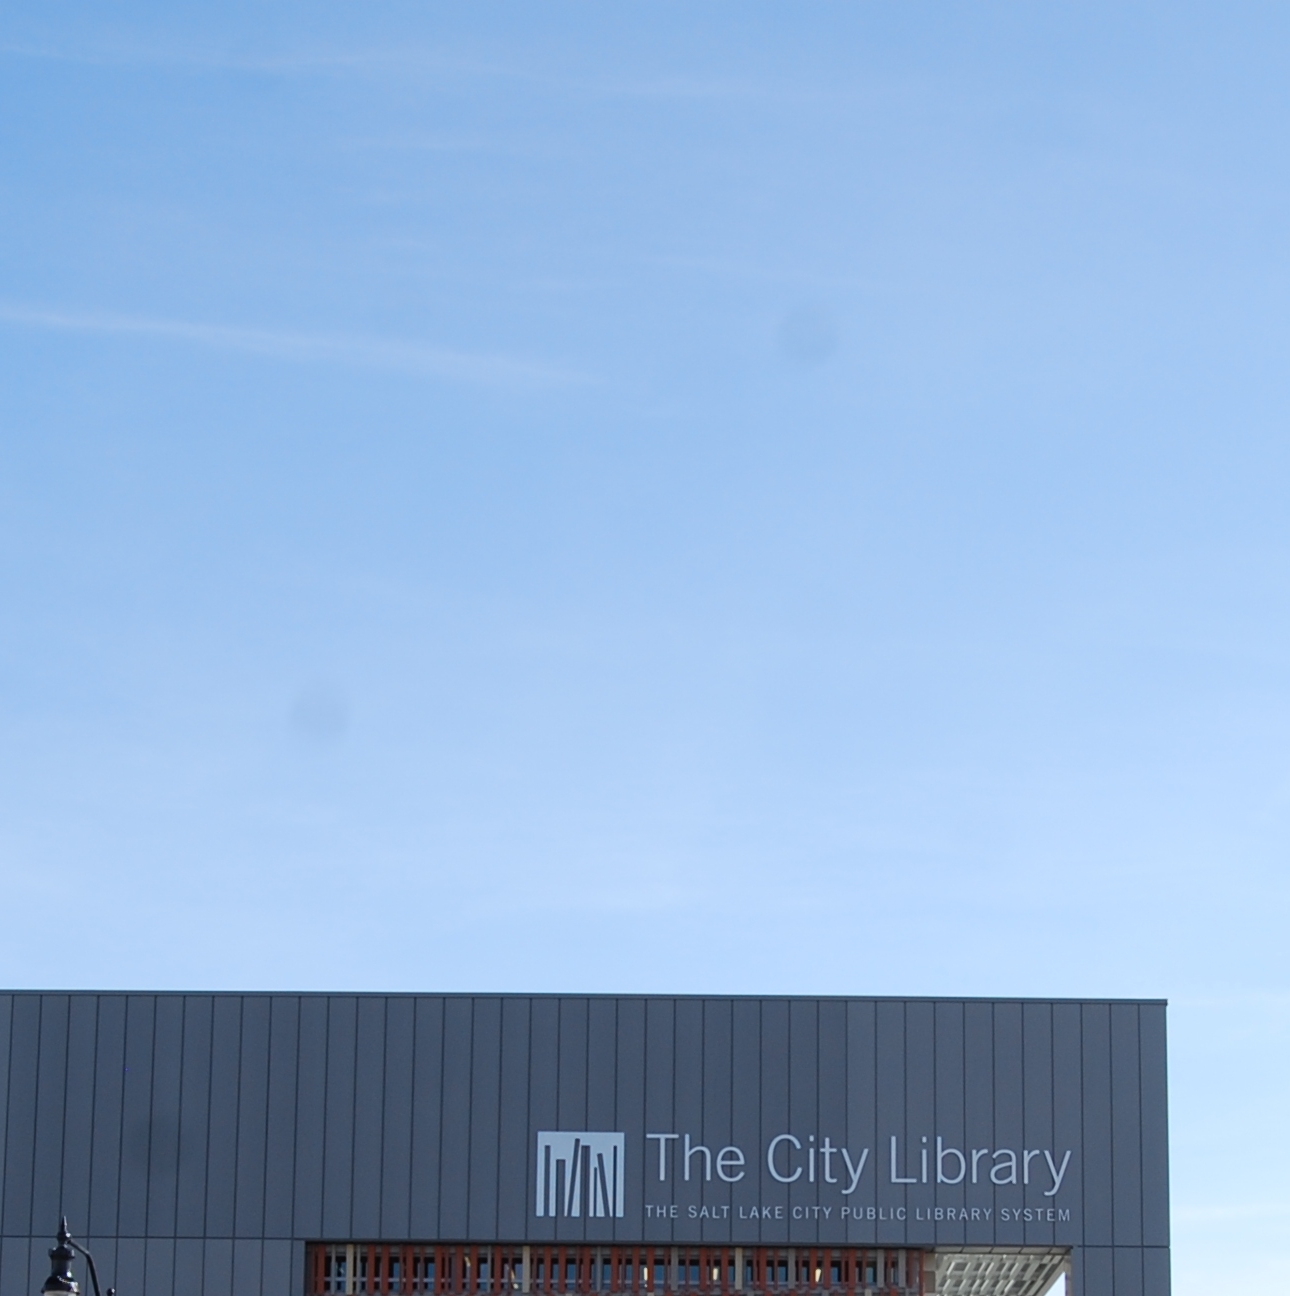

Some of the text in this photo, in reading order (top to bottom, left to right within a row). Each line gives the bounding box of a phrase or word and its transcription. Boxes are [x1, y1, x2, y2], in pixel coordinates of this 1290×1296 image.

[645, 1133, 1072, 1196] The City Library
[645, 1204, 1070, 1222] THE SALT LAKE CITY PUBLIC LIBRARY SYSTEM
